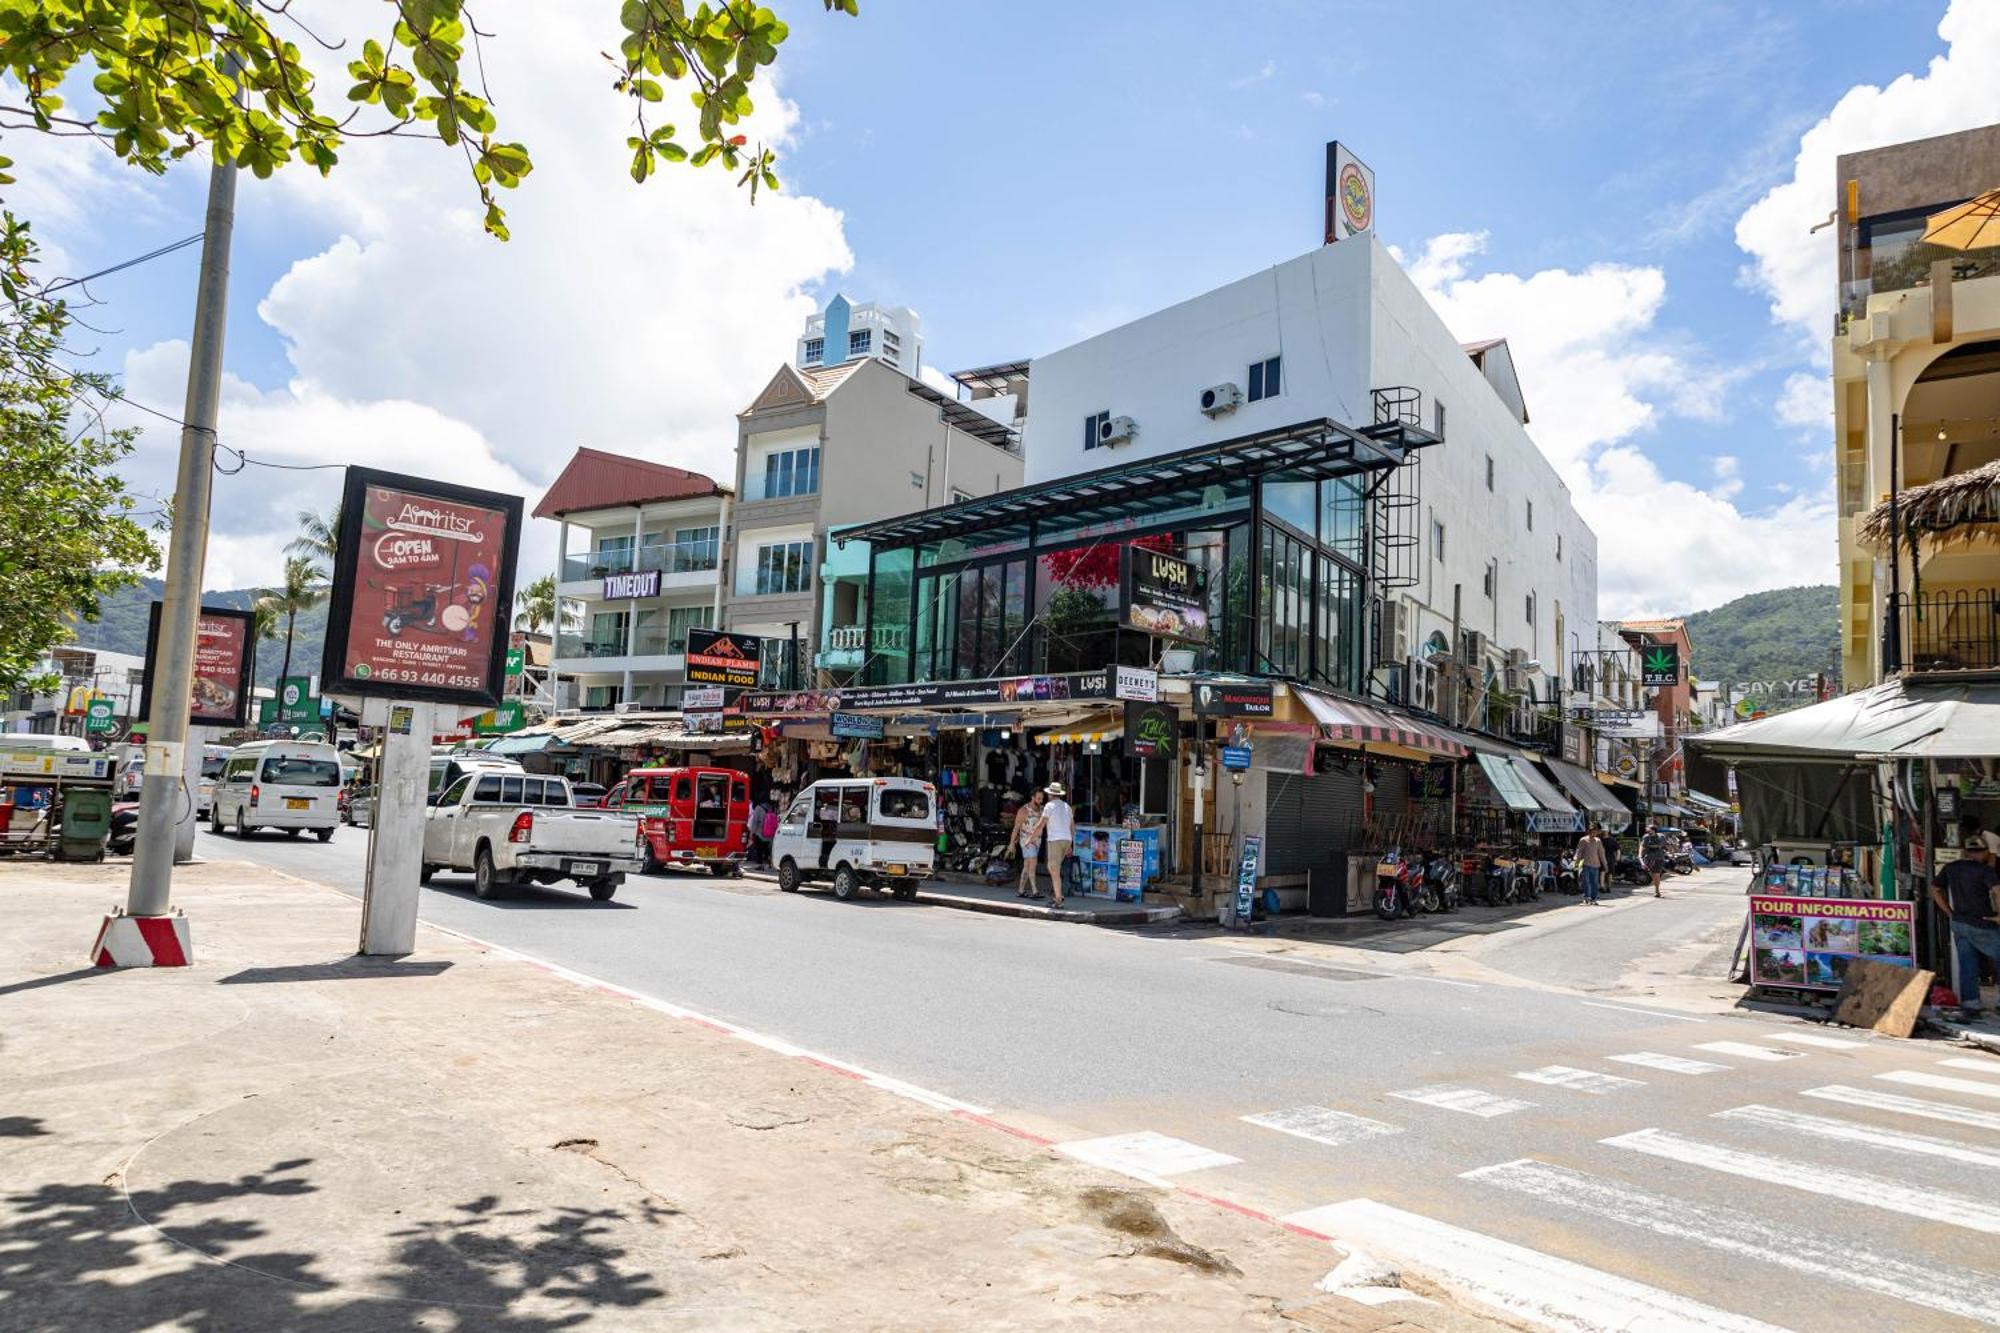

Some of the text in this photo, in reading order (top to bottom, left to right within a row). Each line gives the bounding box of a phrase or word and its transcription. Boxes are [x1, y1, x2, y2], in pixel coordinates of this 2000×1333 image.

[399, 503, 475, 533] Amritsr
[394, 540, 432, 556] OPEN
[387, 553, 439, 565] 9AM TO 4AM
[1152, 556, 1187, 586] LUSH
[606, 571, 657, 599] TIMEOUT
[375, 638, 468, 657] THE ONLY AMRITSARI
[392, 650, 450, 663] RESTAURANT
[692, 654, 756, 669] INDIAN FLAME
[373, 668, 480, 688] +66 93 440 4555
[691, 670, 755, 685] INDIAN FOOD
[1645, 674, 1676, 682] T.H.C.
[1737, 680, 1776, 695] SAY
[1245, 703, 1271, 712] TAILOR
[1753, 900, 1910, 920] TOUR INFORMATION
